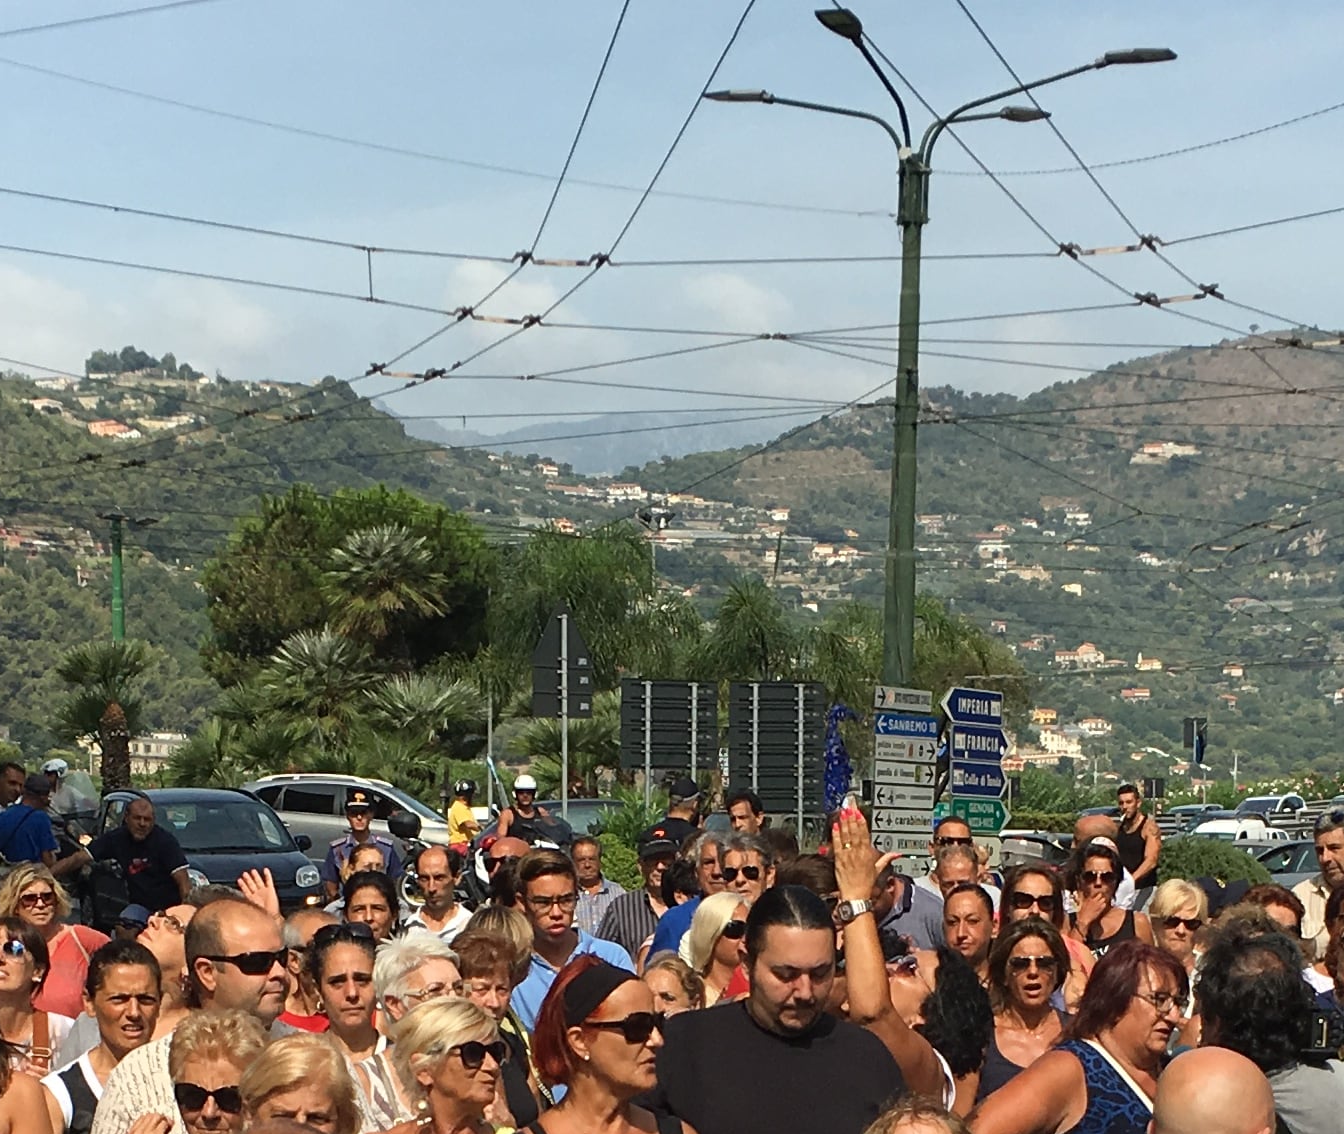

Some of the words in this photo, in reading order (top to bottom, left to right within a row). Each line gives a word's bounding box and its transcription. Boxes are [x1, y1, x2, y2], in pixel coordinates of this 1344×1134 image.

[958, 697, 989, 716] IMPERIA
[887, 718, 928, 733] SANREMO
[966, 734, 999, 752] FRANCIA
[897, 838, 929, 850] VENTIMIGLI
